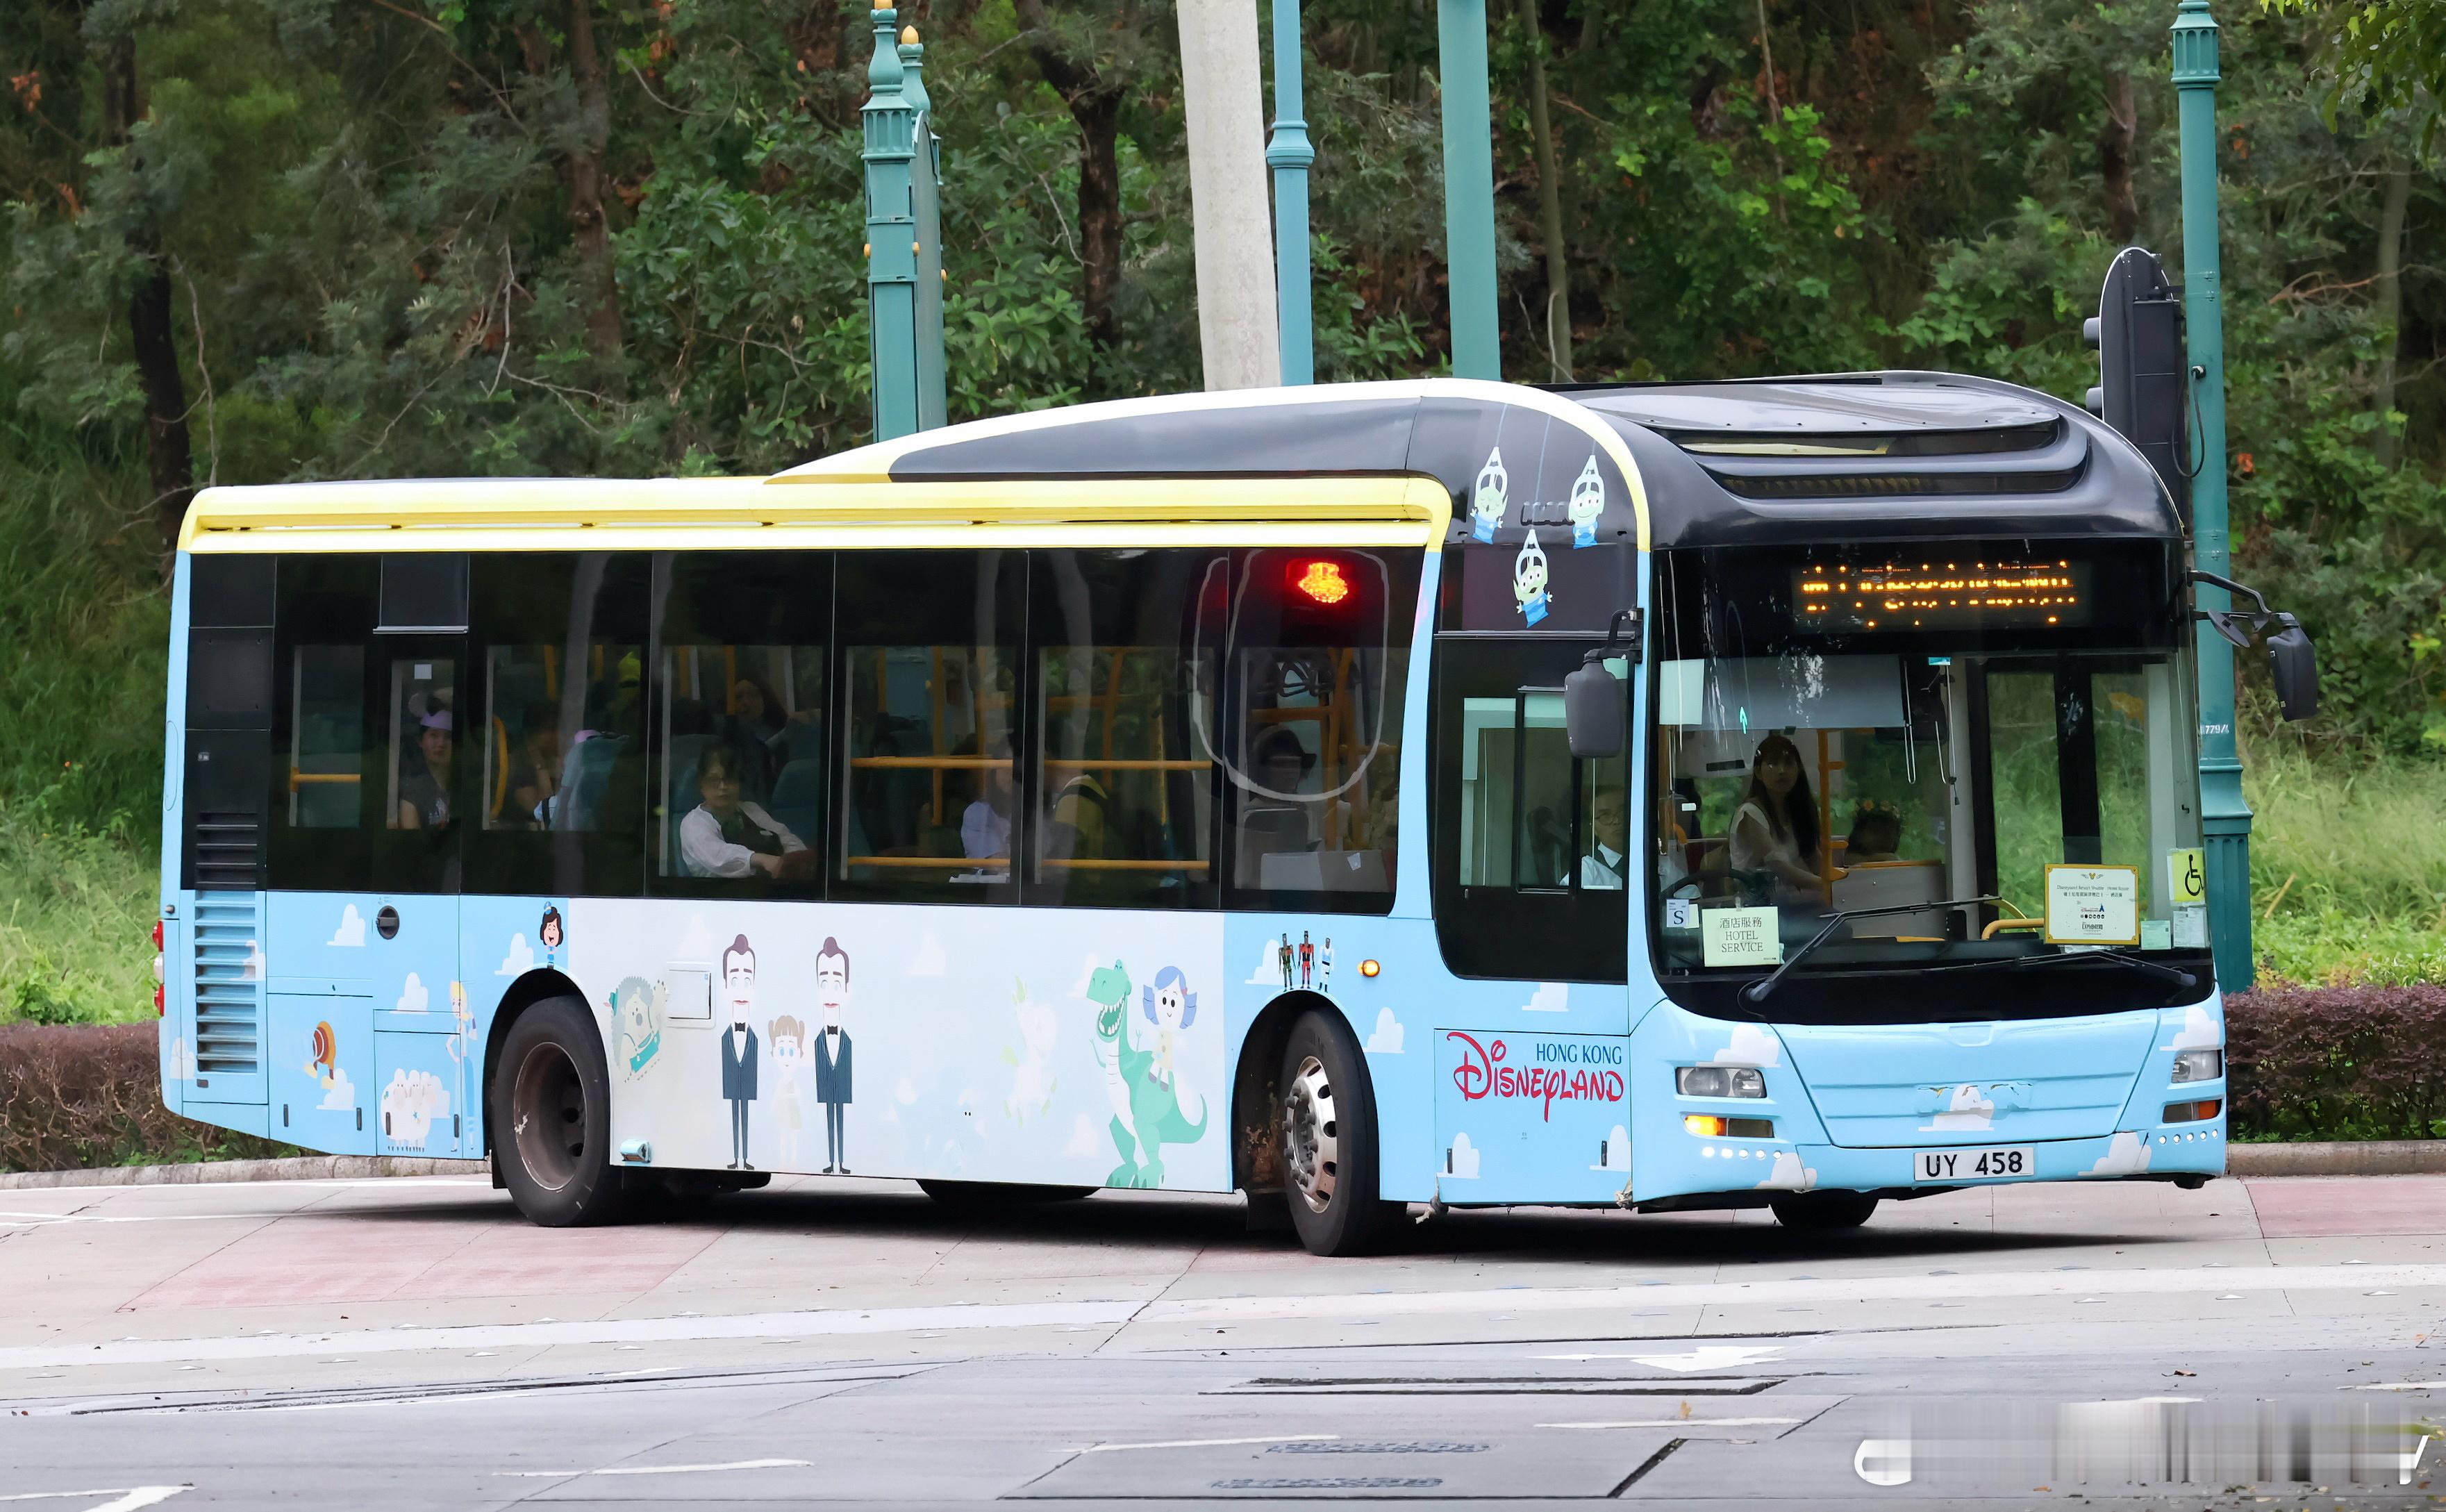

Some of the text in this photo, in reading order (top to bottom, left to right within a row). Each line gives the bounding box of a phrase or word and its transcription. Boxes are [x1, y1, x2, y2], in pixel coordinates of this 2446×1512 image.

[1674, 911, 1683, 924] S
[1720, 916, 1762, 929] 酒店服務
[1725, 930, 1758, 940] HOTEL
[1721, 942, 1763, 953] SERVICE
[1536, 1043, 1622, 1065] HONG KONG
[1926, 1151, 2023, 1177] UY 458
